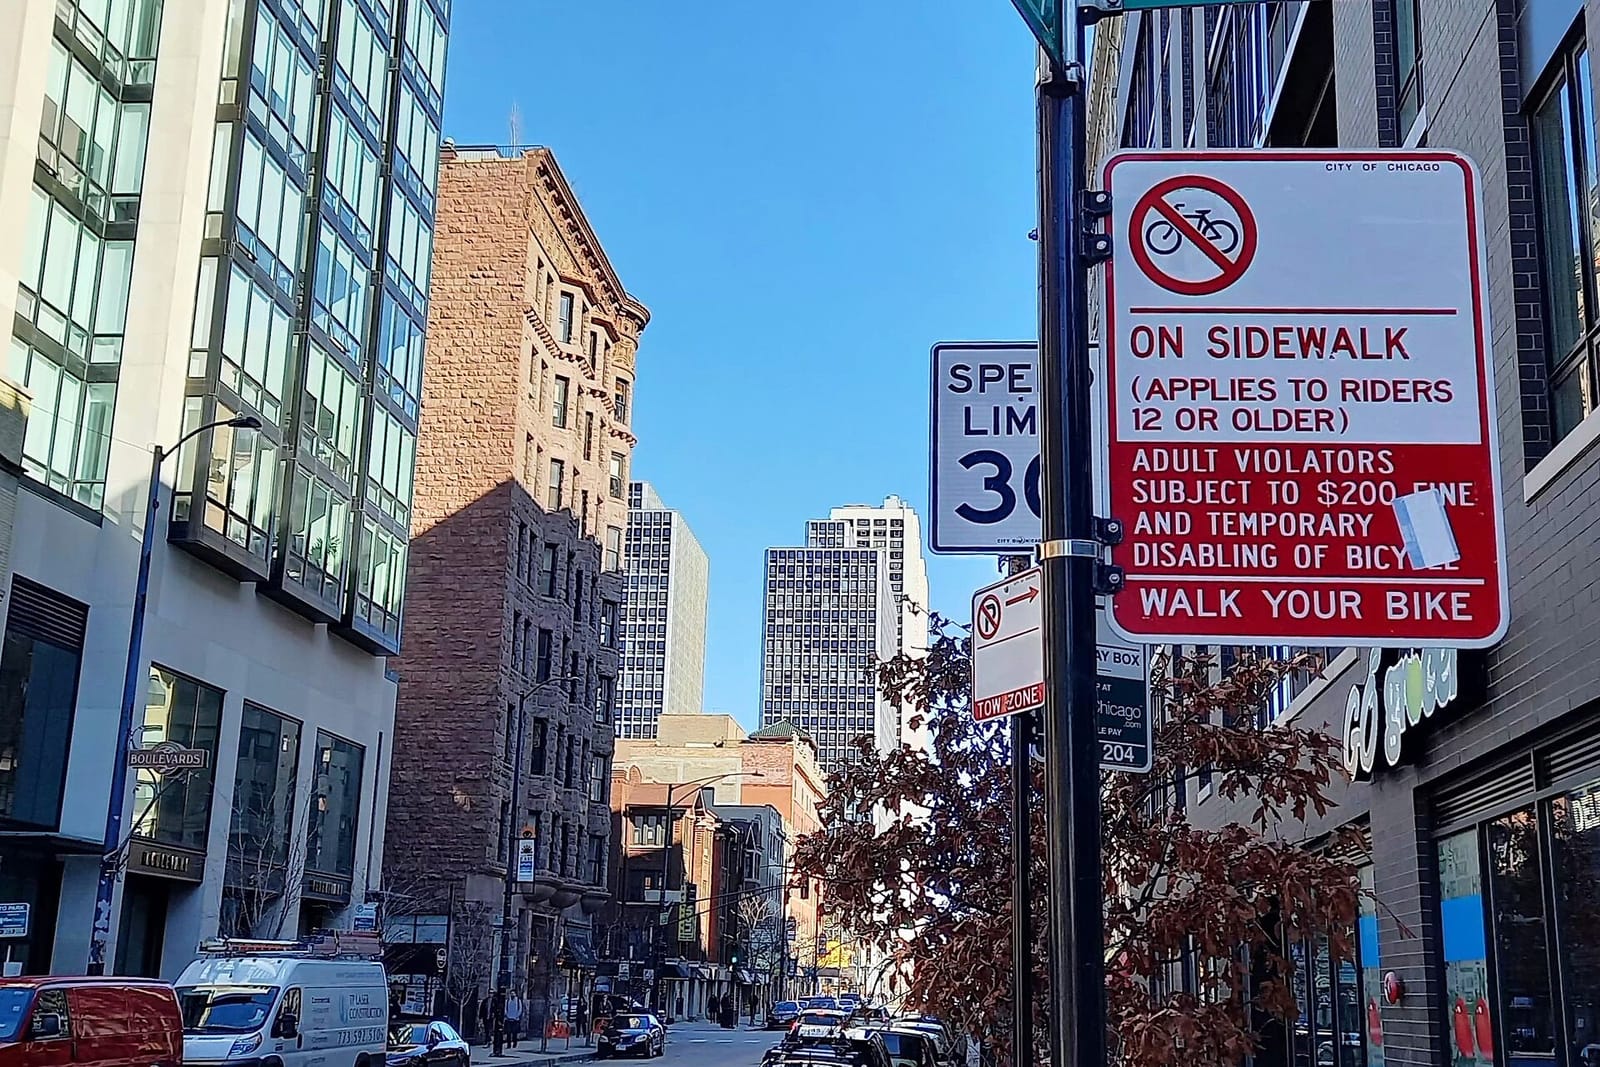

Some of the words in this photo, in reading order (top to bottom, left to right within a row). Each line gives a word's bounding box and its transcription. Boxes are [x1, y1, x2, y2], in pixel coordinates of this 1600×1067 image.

[1325, 163, 1352, 171] CITY
[1362, 163, 1377, 171] OF
[1387, 163, 1440, 171] CHICAGO
[1130, 325, 1183, 359] ON
[1206, 325, 1410, 360] SIDEWALK
[1131, 376, 1277, 403] (APPLIES
[1287, 379, 1328, 402] TO
[1340, 379, 1454, 403] RIDERS
[964, 405, 1037, 436] LIM
[1132, 408, 1162, 431] 12
[1175, 407, 1219, 431] OR
[1231, 407, 1349, 434] OLDER)
[1132, 448, 1218, 472] ADULT
[1234, 449, 1395, 474] VIOLATORS
[954, 449, 1042, 525] 3
[1132, 479, 1252, 505] SUBJECT
[1266, 480, 1300, 505] TO
[1317, 479, 1397, 508] $200
[1133, 511, 1192, 535] AND
[1206, 511, 1374, 537] TEMPORARY
[1133, 542, 1278, 569] DISABLING
[1294, 543, 1329, 569] OF
[1346, 545, 1460, 571] BICY
[1139, 587, 1243, 617] WALK
[1261, 589, 1363, 619] YOUR
[1385, 591, 1473, 621] BIKE
[1113, 652, 1140, 667] BOX
[1102, 684, 1112, 692] AT
[977, 695, 1001, 719] TOW
[1007, 686, 1040, 711] ZONE
[1107, 728, 1122, 737] PAY
[130, 753, 201, 765] BOULEVARDS
[1103, 743, 1135, 763] 204
